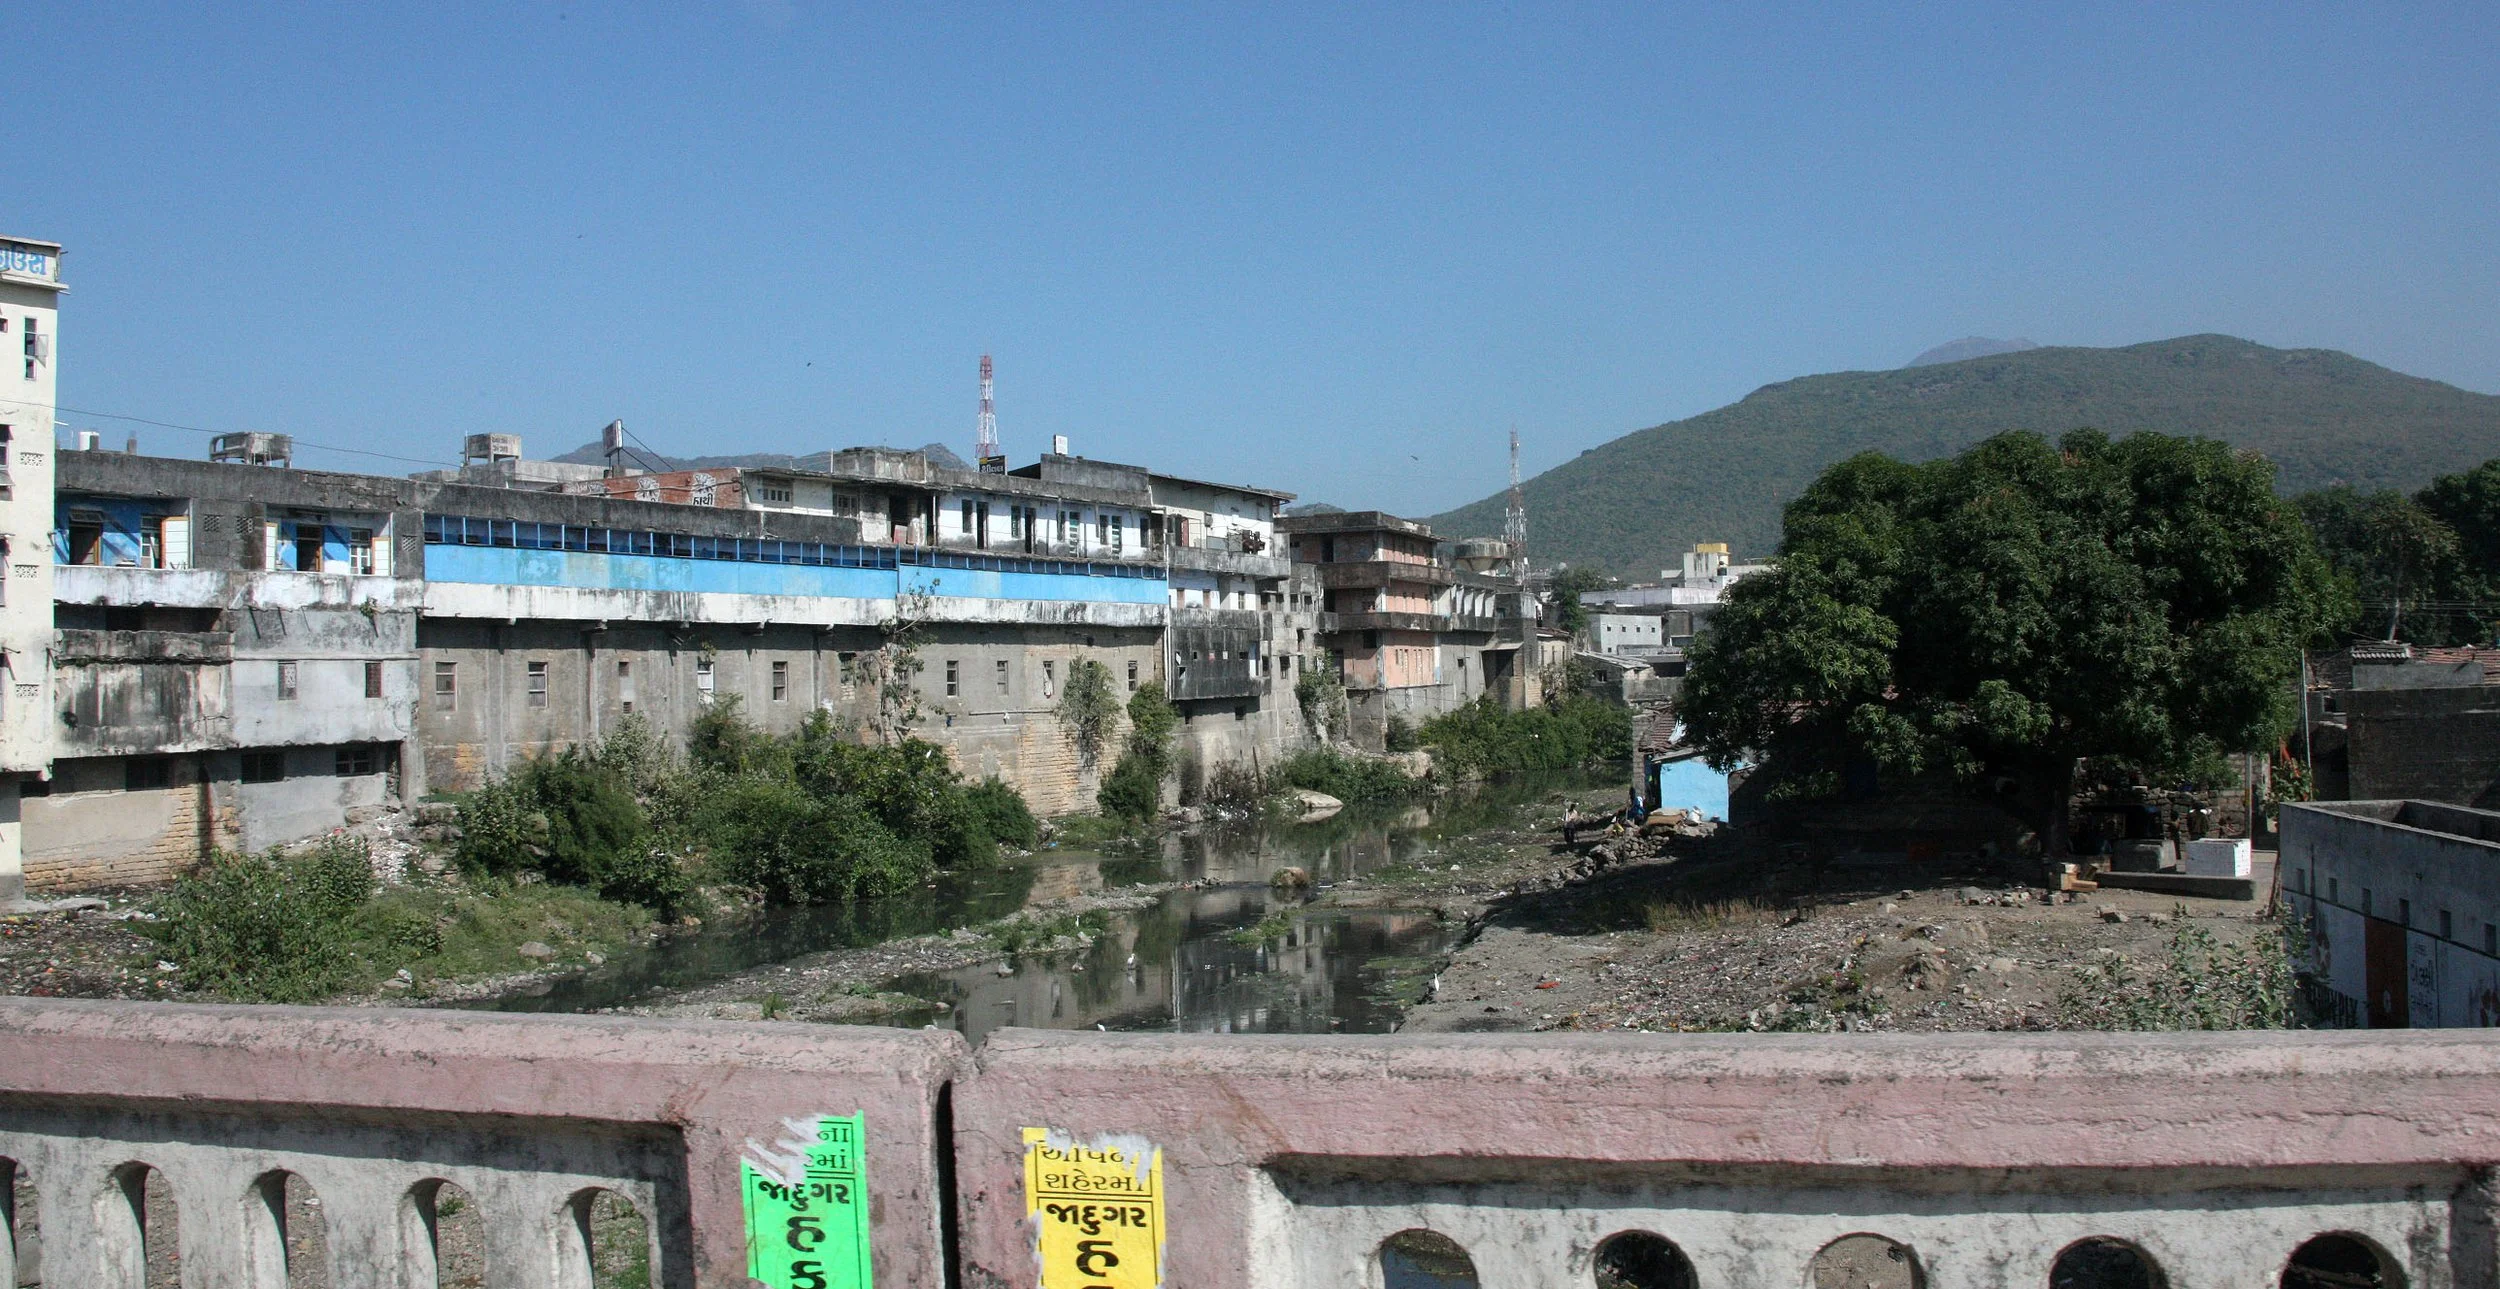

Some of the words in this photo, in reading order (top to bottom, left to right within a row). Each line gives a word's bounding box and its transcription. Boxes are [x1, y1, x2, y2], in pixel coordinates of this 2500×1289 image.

[816, 1127, 849, 1143] ના
[758, 1181, 850, 1212] જાદુગર
[1046, 1203, 1147, 1236] જાદુગર
